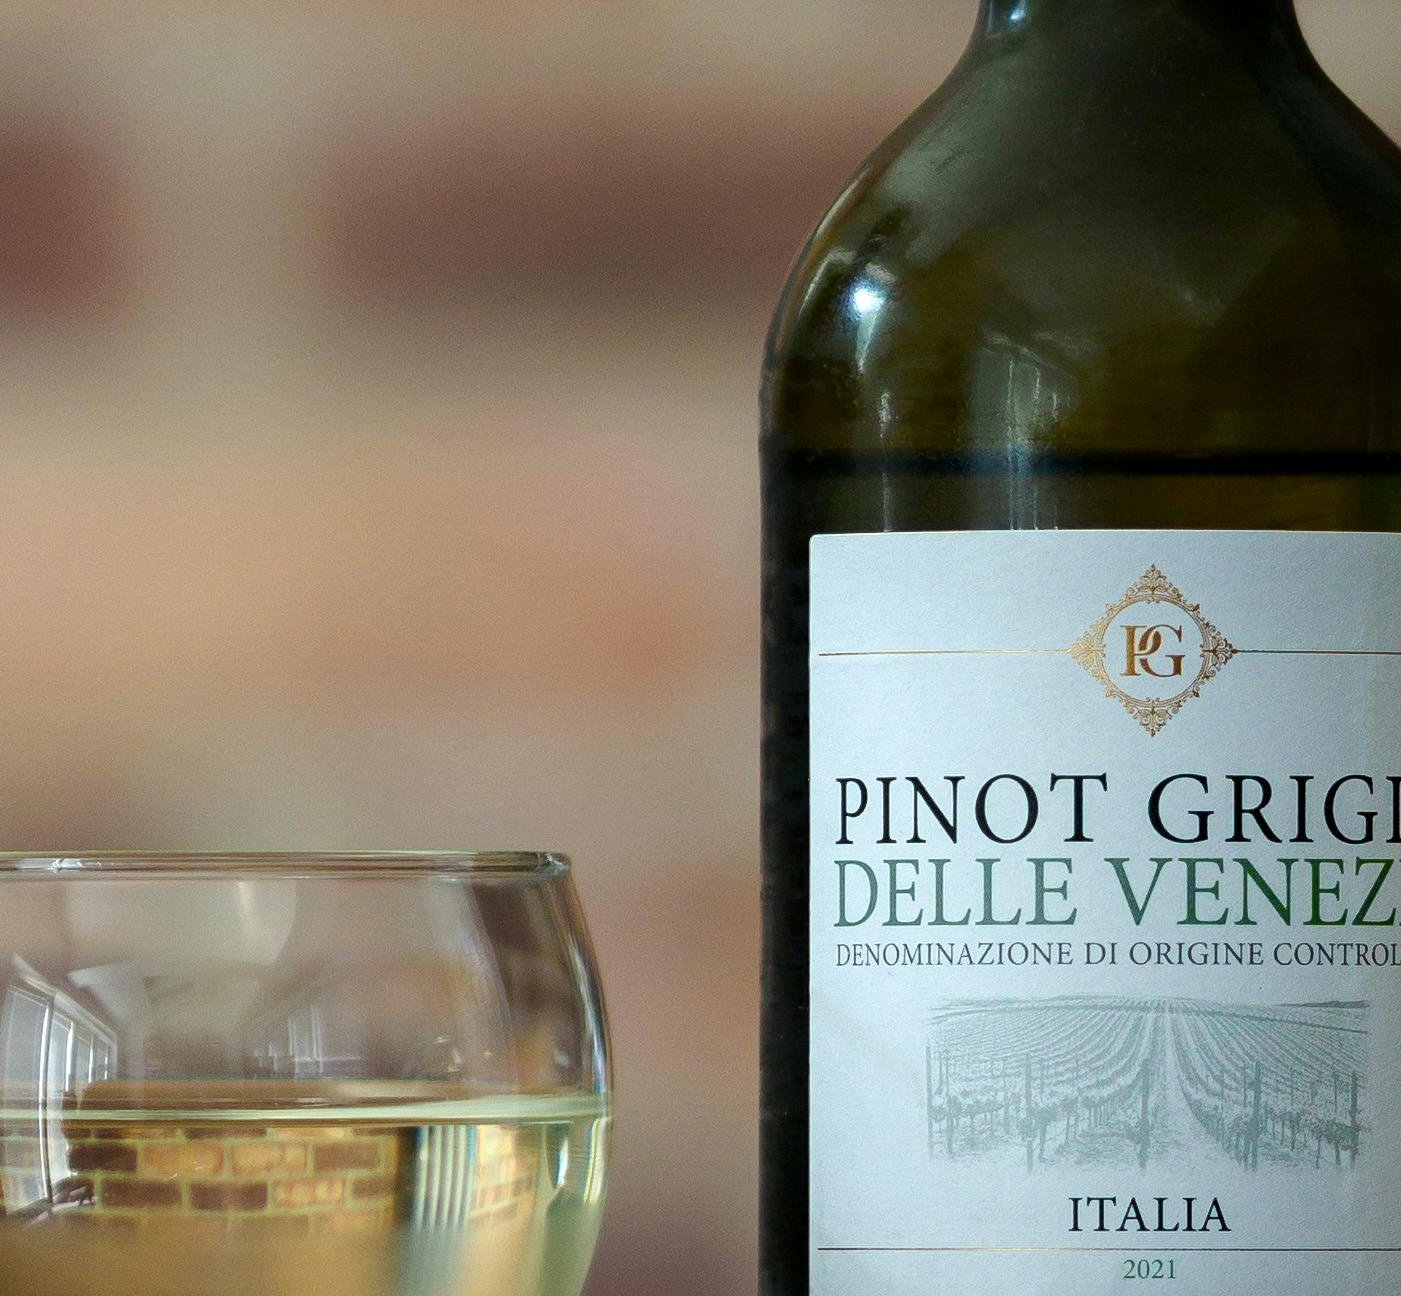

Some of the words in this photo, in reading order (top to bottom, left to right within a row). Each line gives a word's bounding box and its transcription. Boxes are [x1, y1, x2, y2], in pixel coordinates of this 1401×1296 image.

[1120, 623, 1183, 678] PG
[835, 773, 1107, 845] PINOT
[833, 858, 1078, 927] DELLE
[835, 941, 1074, 967] DENOMINAZIONE
[1084, 942, 1118, 966] DI
[1128, 941, 1265, 966] ORIGINE
[1067, 1196, 1232, 1232] ITALIA
[1122, 1258, 1177, 1281] 2021
